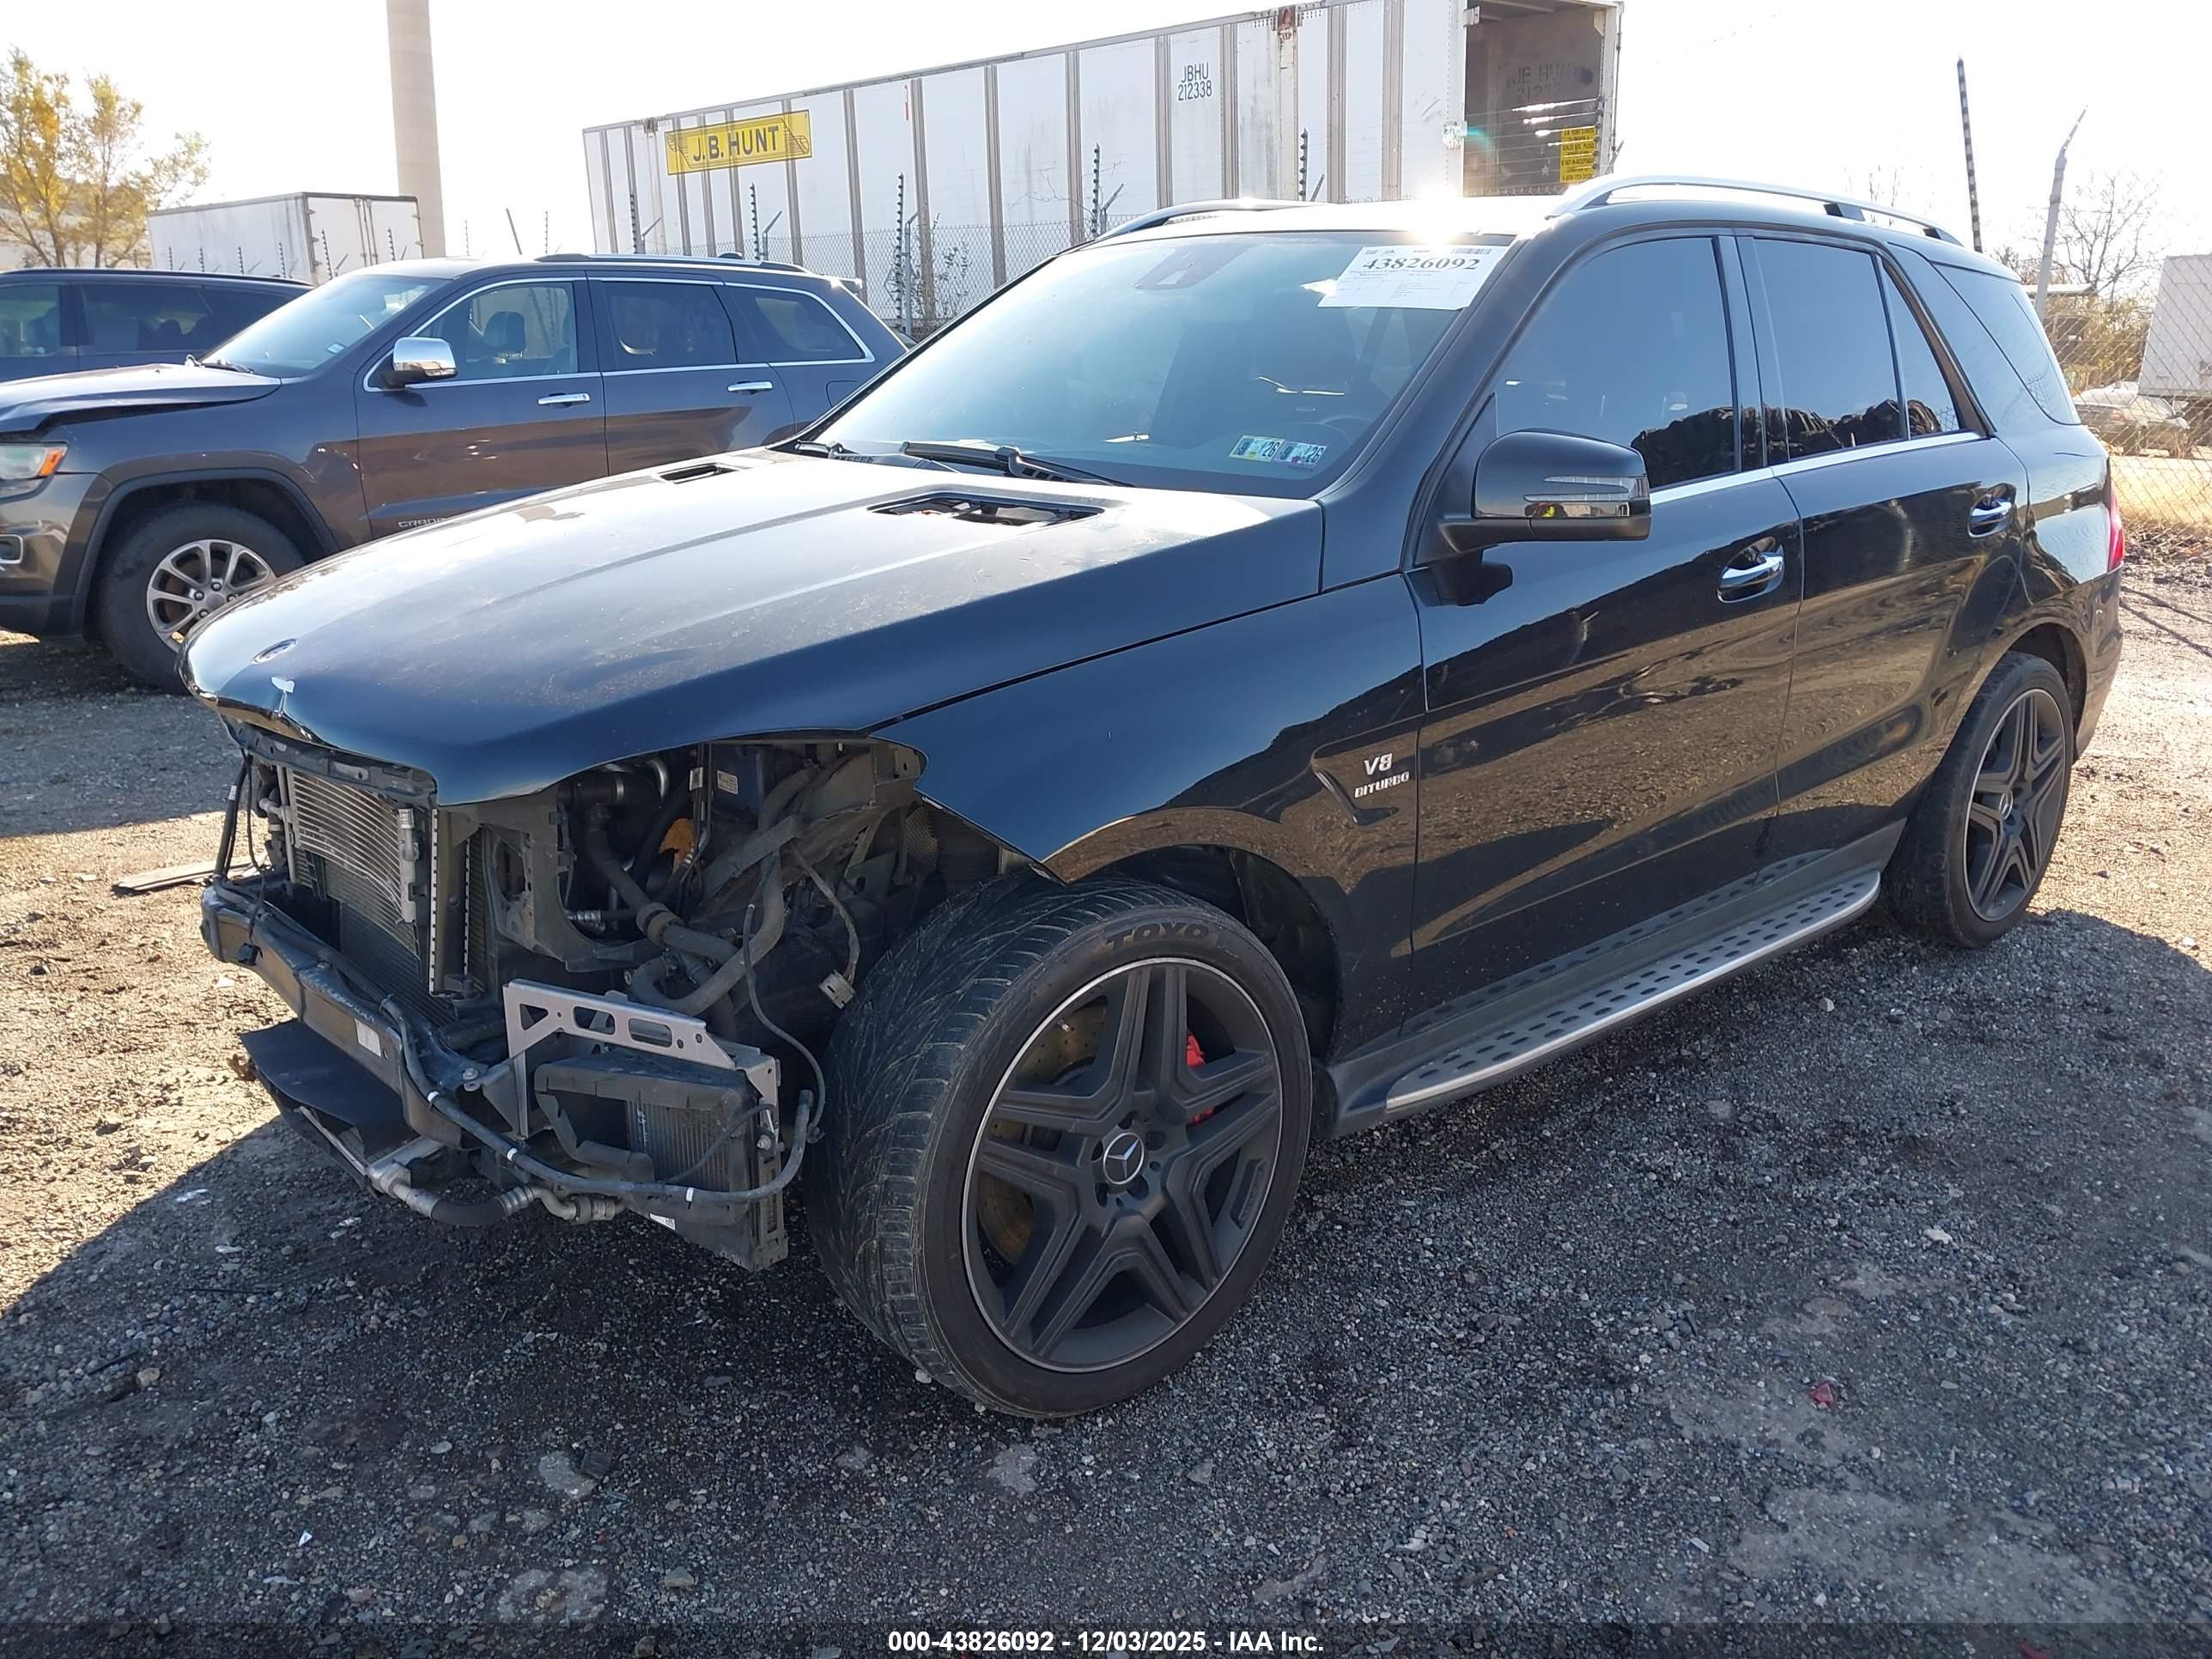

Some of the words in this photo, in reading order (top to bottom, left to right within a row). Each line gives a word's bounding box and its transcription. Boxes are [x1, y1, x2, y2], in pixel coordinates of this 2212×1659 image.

[1181, 62, 1209, 83] JBHU
[1177, 80, 1212, 101] 212338
[692, 135, 724, 162] J.B.
[727, 126, 780, 156] HUNT
[1363, 258, 1481, 270] 43826092
[1364, 752, 1393, 776] V8
[1354, 771, 1410, 799] BITURBO
[1104, 921, 1210, 951] TOYO
